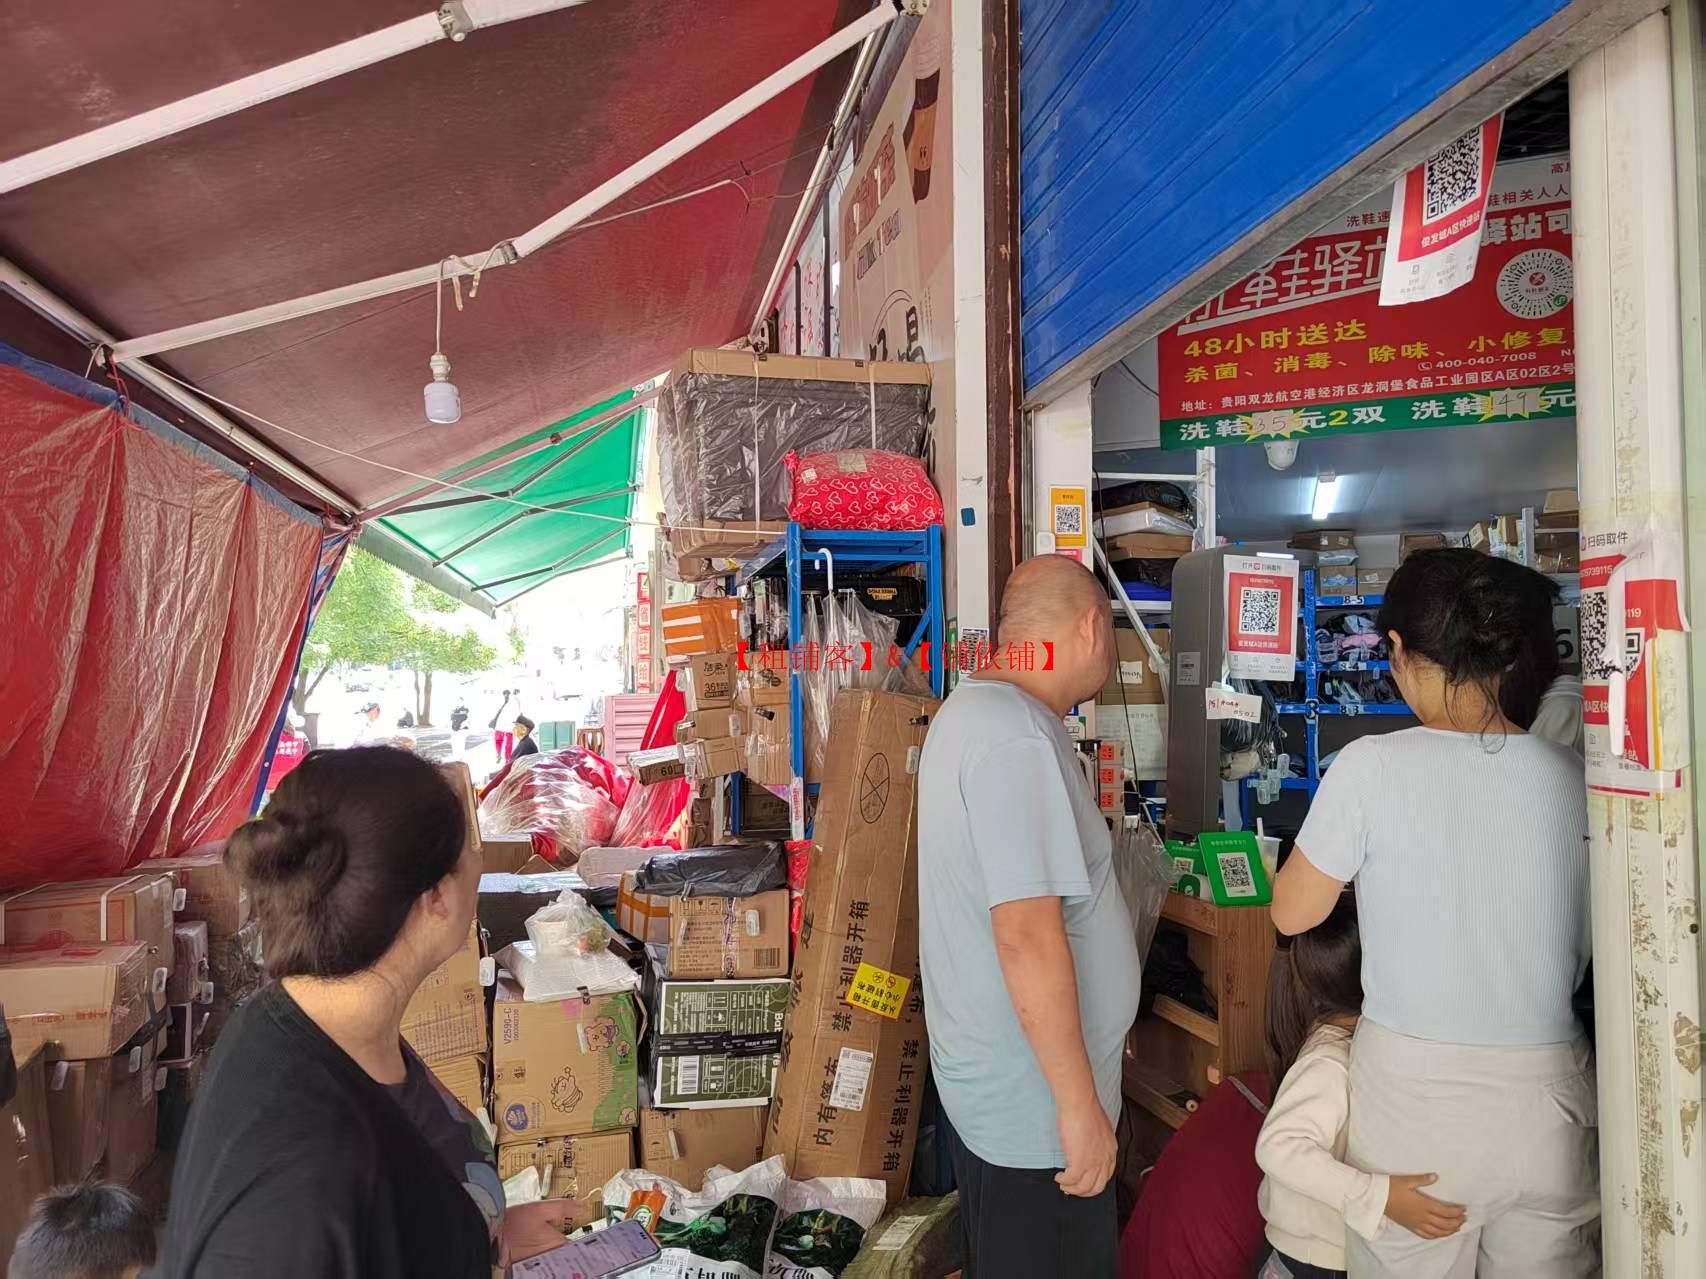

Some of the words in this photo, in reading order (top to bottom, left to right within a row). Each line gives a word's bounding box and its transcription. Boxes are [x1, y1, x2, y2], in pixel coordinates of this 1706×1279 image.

[1184, 319, 1366, 357] 48小时送达
[1436, 352, 1537, 369] 400-040-7008
[1588, 531, 1628, 547] 扫码取件
[504, 1007, 512, 1045] V2590-C
